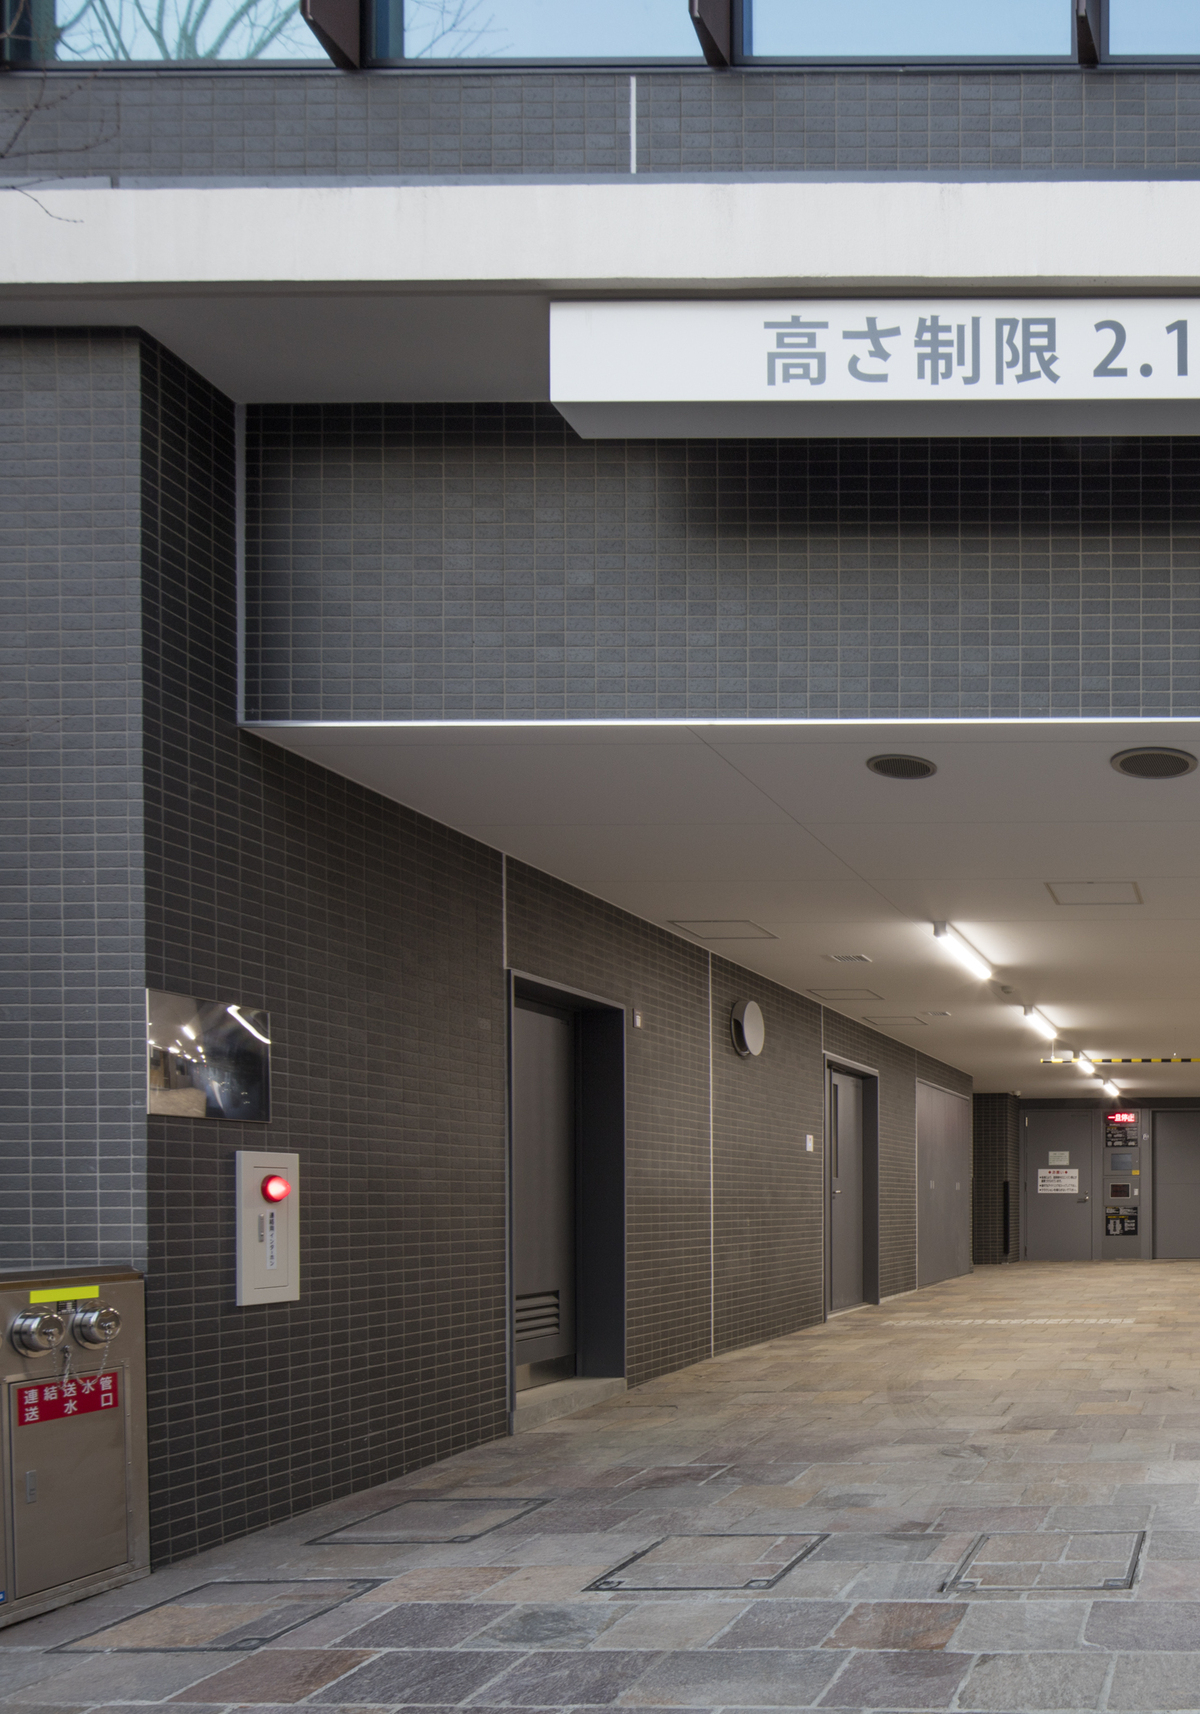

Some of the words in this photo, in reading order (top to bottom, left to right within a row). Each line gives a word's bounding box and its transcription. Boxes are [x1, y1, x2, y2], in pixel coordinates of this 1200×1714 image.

[764, 315, 1061, 386] 高さ制限
[24, 1376, 113, 1405] 連結送水管
[24, 1393, 113, 1423] 送水口
